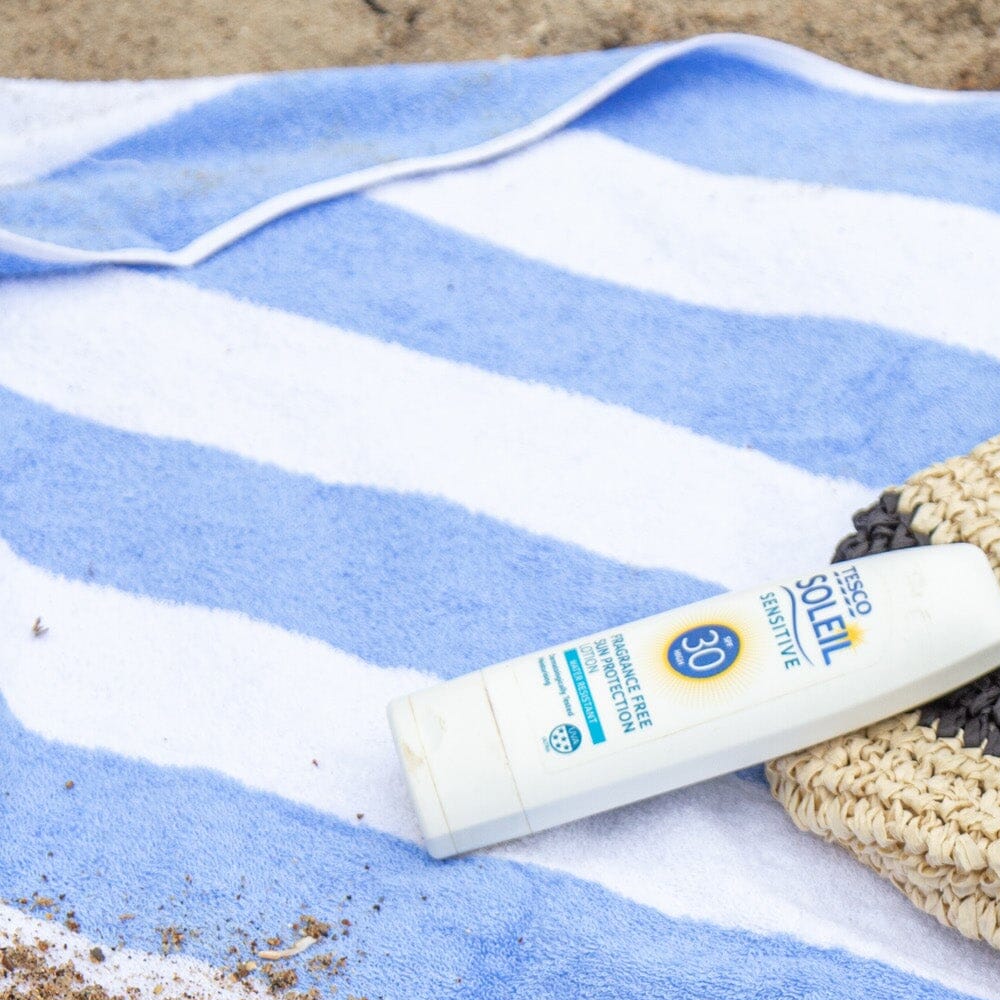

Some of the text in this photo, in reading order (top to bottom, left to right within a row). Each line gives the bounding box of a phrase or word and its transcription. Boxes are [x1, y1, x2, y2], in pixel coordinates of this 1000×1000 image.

[796, 574, 852, 666] SOLEIL
[842, 566, 872, 615] TESCO
[580, 643, 598, 674] LOTION
[681, 629, 726, 671] 30
[760, 592, 801, 670] SENSITIVE
[570, 659, 598, 723] WATER RESISTANT
[594, 638, 636, 734] SUN PROTECTION
[611, 633, 653, 729] FRAGRANCE FREE
[567, 727, 580, 745] UVA
